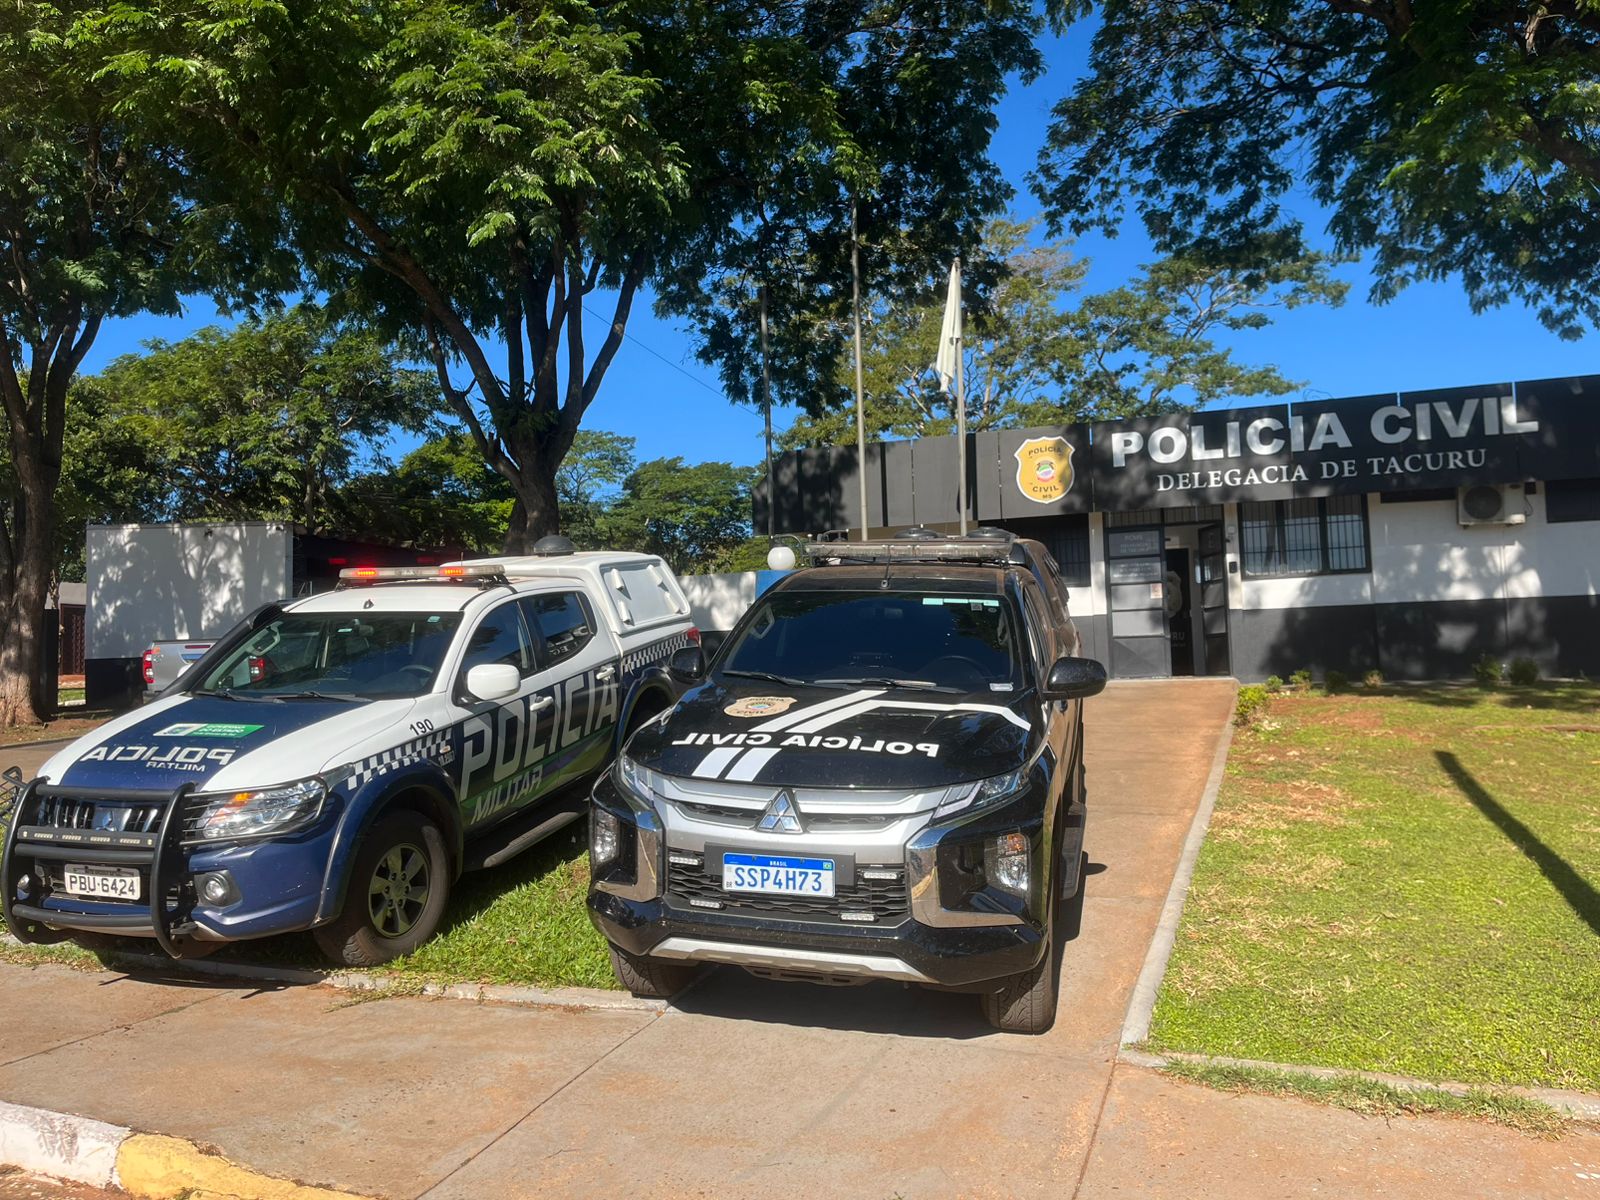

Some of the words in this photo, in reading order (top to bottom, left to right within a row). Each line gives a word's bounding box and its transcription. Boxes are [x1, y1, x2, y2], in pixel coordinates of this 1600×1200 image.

[1111, 412, 1352, 468] POLICIA
[1370, 396, 1539, 445] CIVIL
[1032, 485, 1059, 493] CIVIL
[1157, 464, 1309, 491] DELEGACIA
[1320, 459, 1358, 479] DE
[1367, 449, 1487, 476] TACURU
[409, 718, 434, 736] 190
[459, 666, 620, 802] POLICIA
[471, 764, 544, 825] MILITAR
[734, 867, 822, 892] SSP4H73
